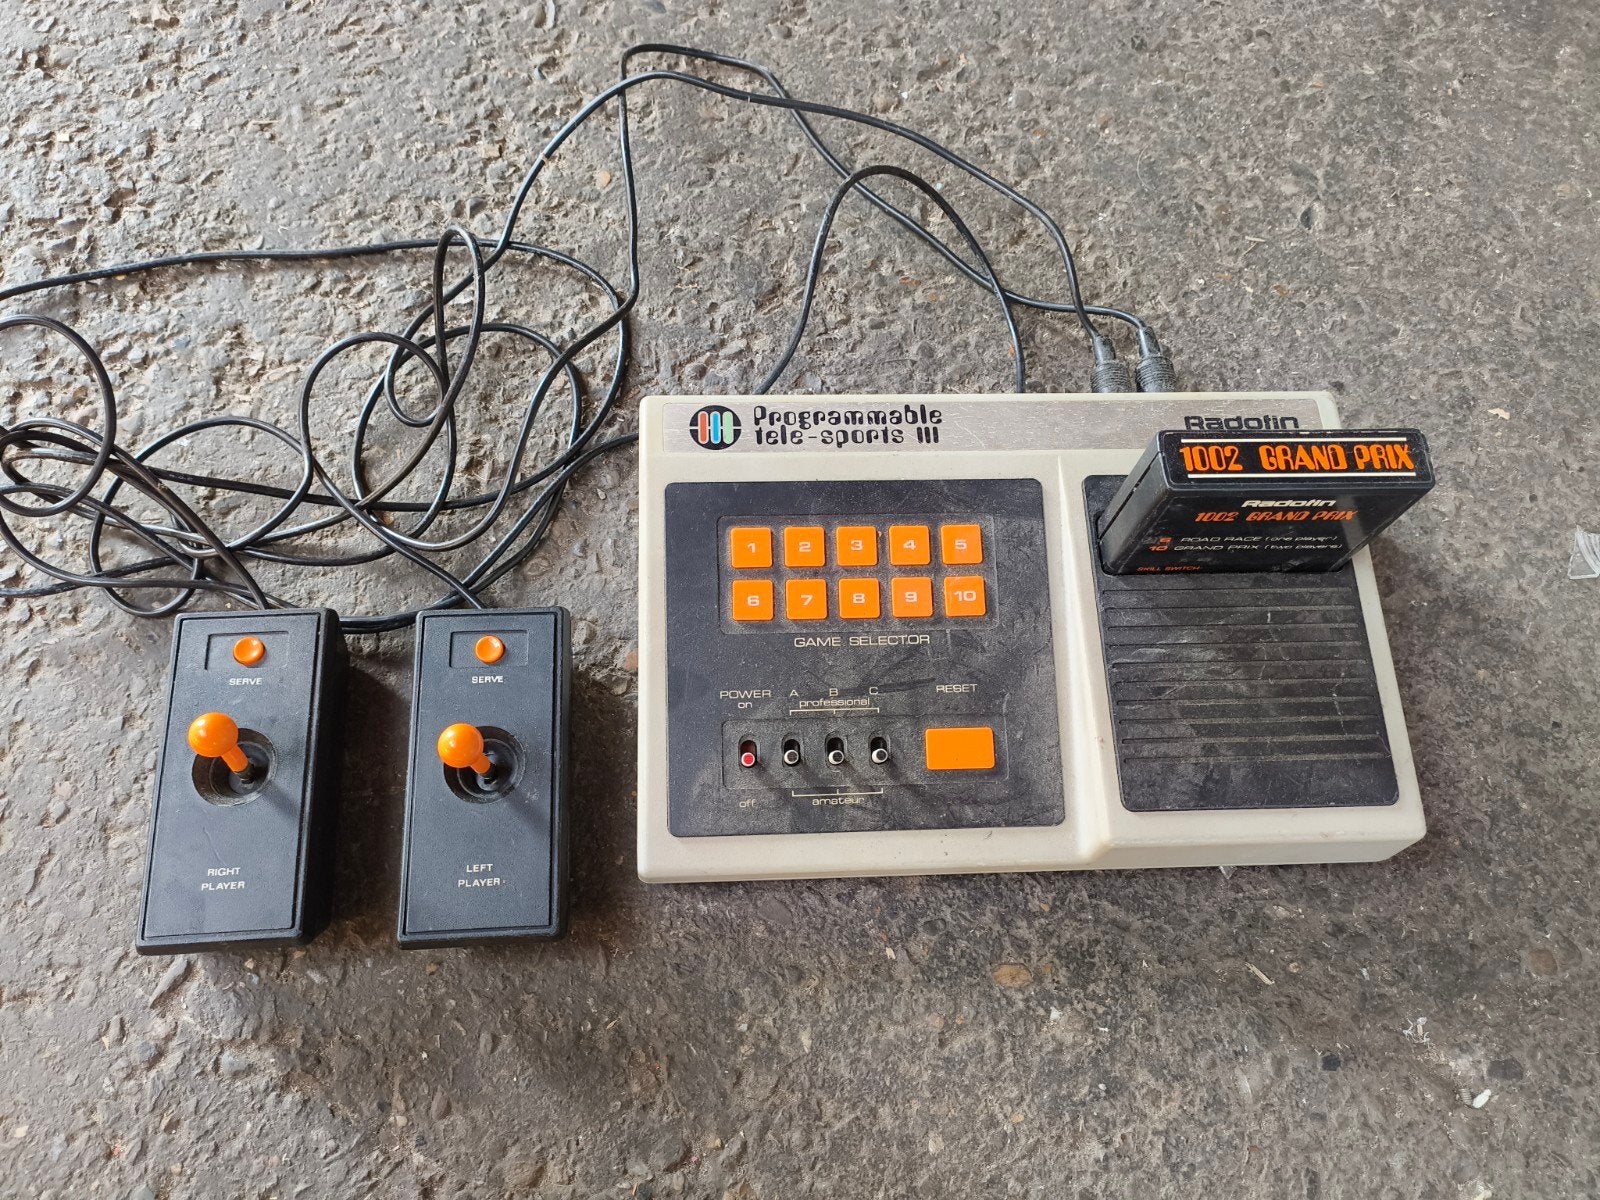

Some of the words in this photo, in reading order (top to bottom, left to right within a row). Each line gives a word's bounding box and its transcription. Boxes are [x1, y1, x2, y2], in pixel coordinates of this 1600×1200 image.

[753, 404, 942, 430] Programmable
[1184, 414, 1299, 430] Radofin
[755, 425, 904, 448] tele-sports
[917, 426, 940, 443] III
[1180, 445, 1243, 471] 1002
[1258, 444, 1348, 470] GRAND
[1354, 443, 1415, 469] PRIX
[1241, 499, 1336, 508] Radofin
[1194, 511, 1239, 522] 1002
[1245, 511, 1311, 521] GRAND
[1311, 510, 1358, 521] PRIX
[747, 542, 756, 553] 1
[798, 541, 811, 552] 2
[850, 539, 864, 551] 3
[903, 539, 917, 550] 4
[954, 539, 967, 550] 5
[747, 596, 759, 607] 6
[801, 594, 813, 606] 7
[853, 593, 865, 604] 8
[905, 591, 917, 602] 9
[954, 591, 976, 602] 10
[793, 636, 841, 648] GAME
[849, 634, 930, 647] SELECTOR
[228, 677, 262, 686] SERVE
[471, 675, 503, 684] SERVE
[789, 689, 798, 697] A
[829, 688, 838, 697] B
[869, 686, 879, 696] C
[935, 683, 977, 693] RESET
[720, 689, 771, 699] POWER
[799, 697, 870, 708] professional
[739, 799, 756, 808] off
[812, 796, 864, 805] amateur
[207, 867, 241, 877] RIGHT
[466, 863, 493, 873] LEFT
[201, 880, 245, 891] PLAYER
[458, 877, 501, 887] PLAYER
